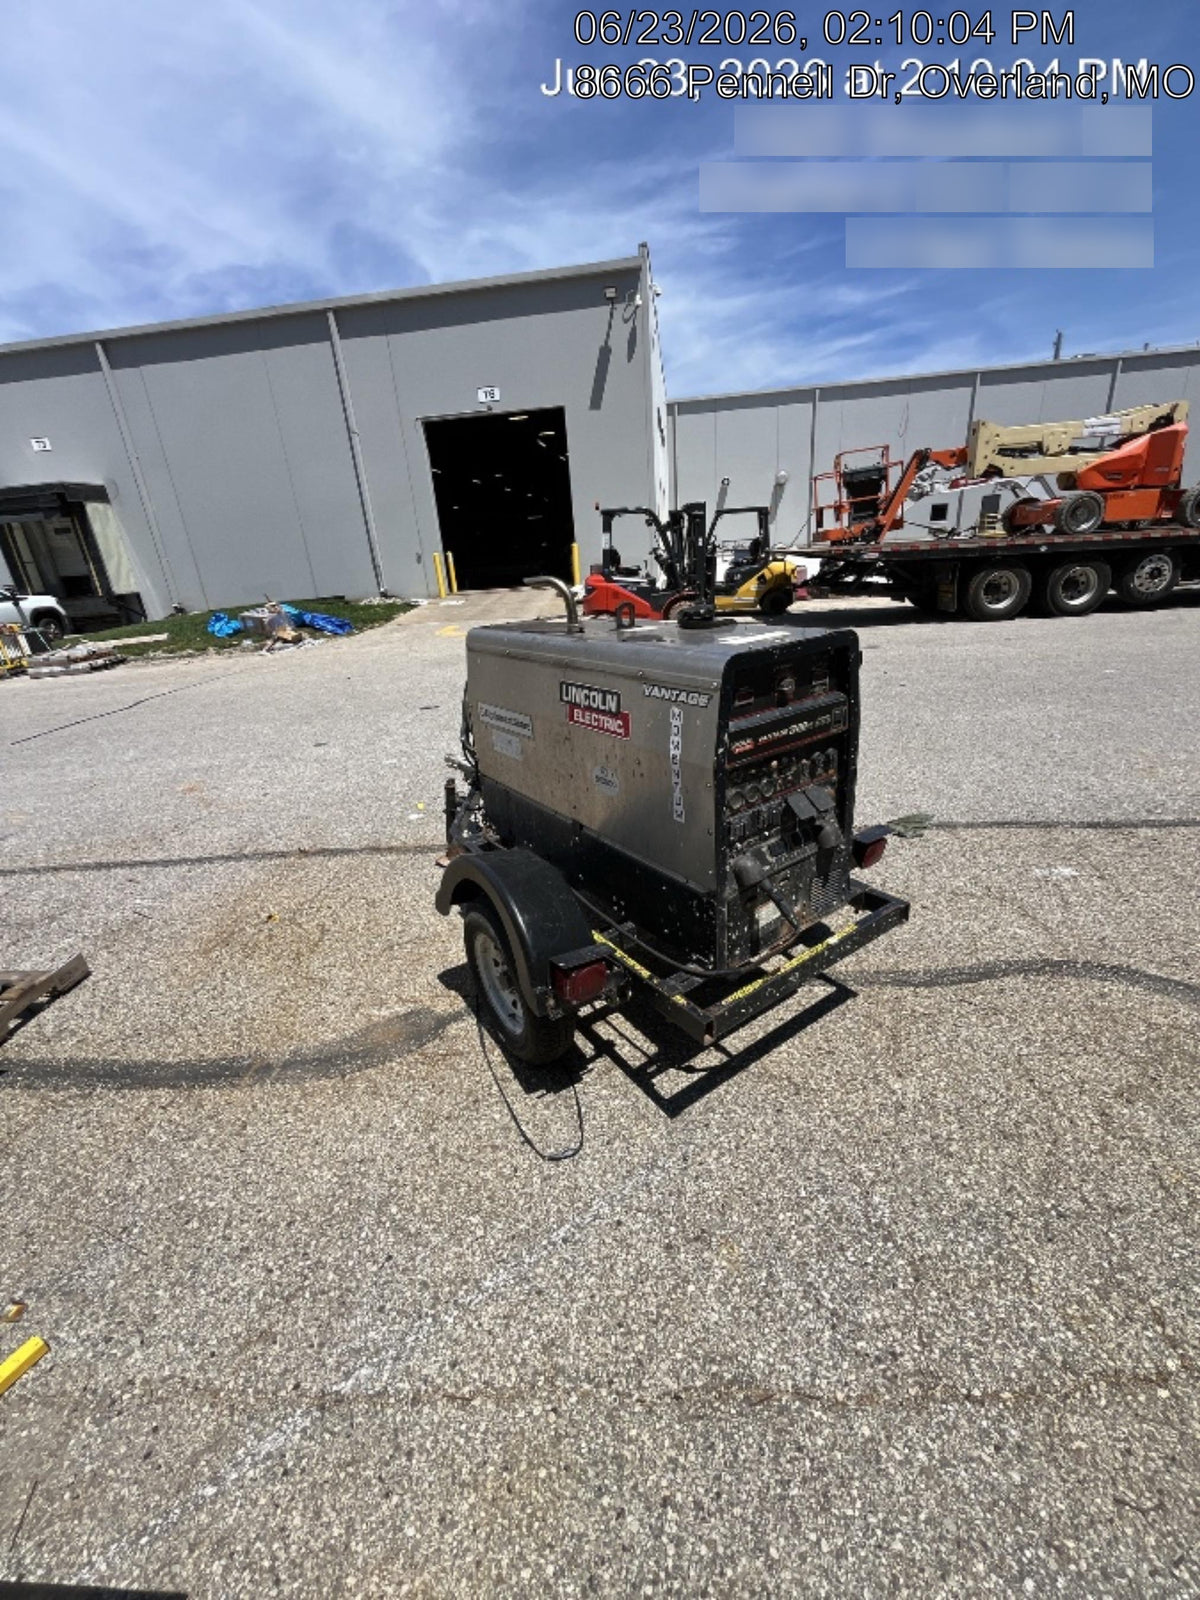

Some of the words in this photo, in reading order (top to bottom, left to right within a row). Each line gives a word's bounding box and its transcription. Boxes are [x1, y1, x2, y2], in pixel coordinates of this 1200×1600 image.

[561, 683, 618, 714] LINCOLN
[643, 684, 713, 708] VANTAGE
[573, 708, 625, 735] ELECTRIC
